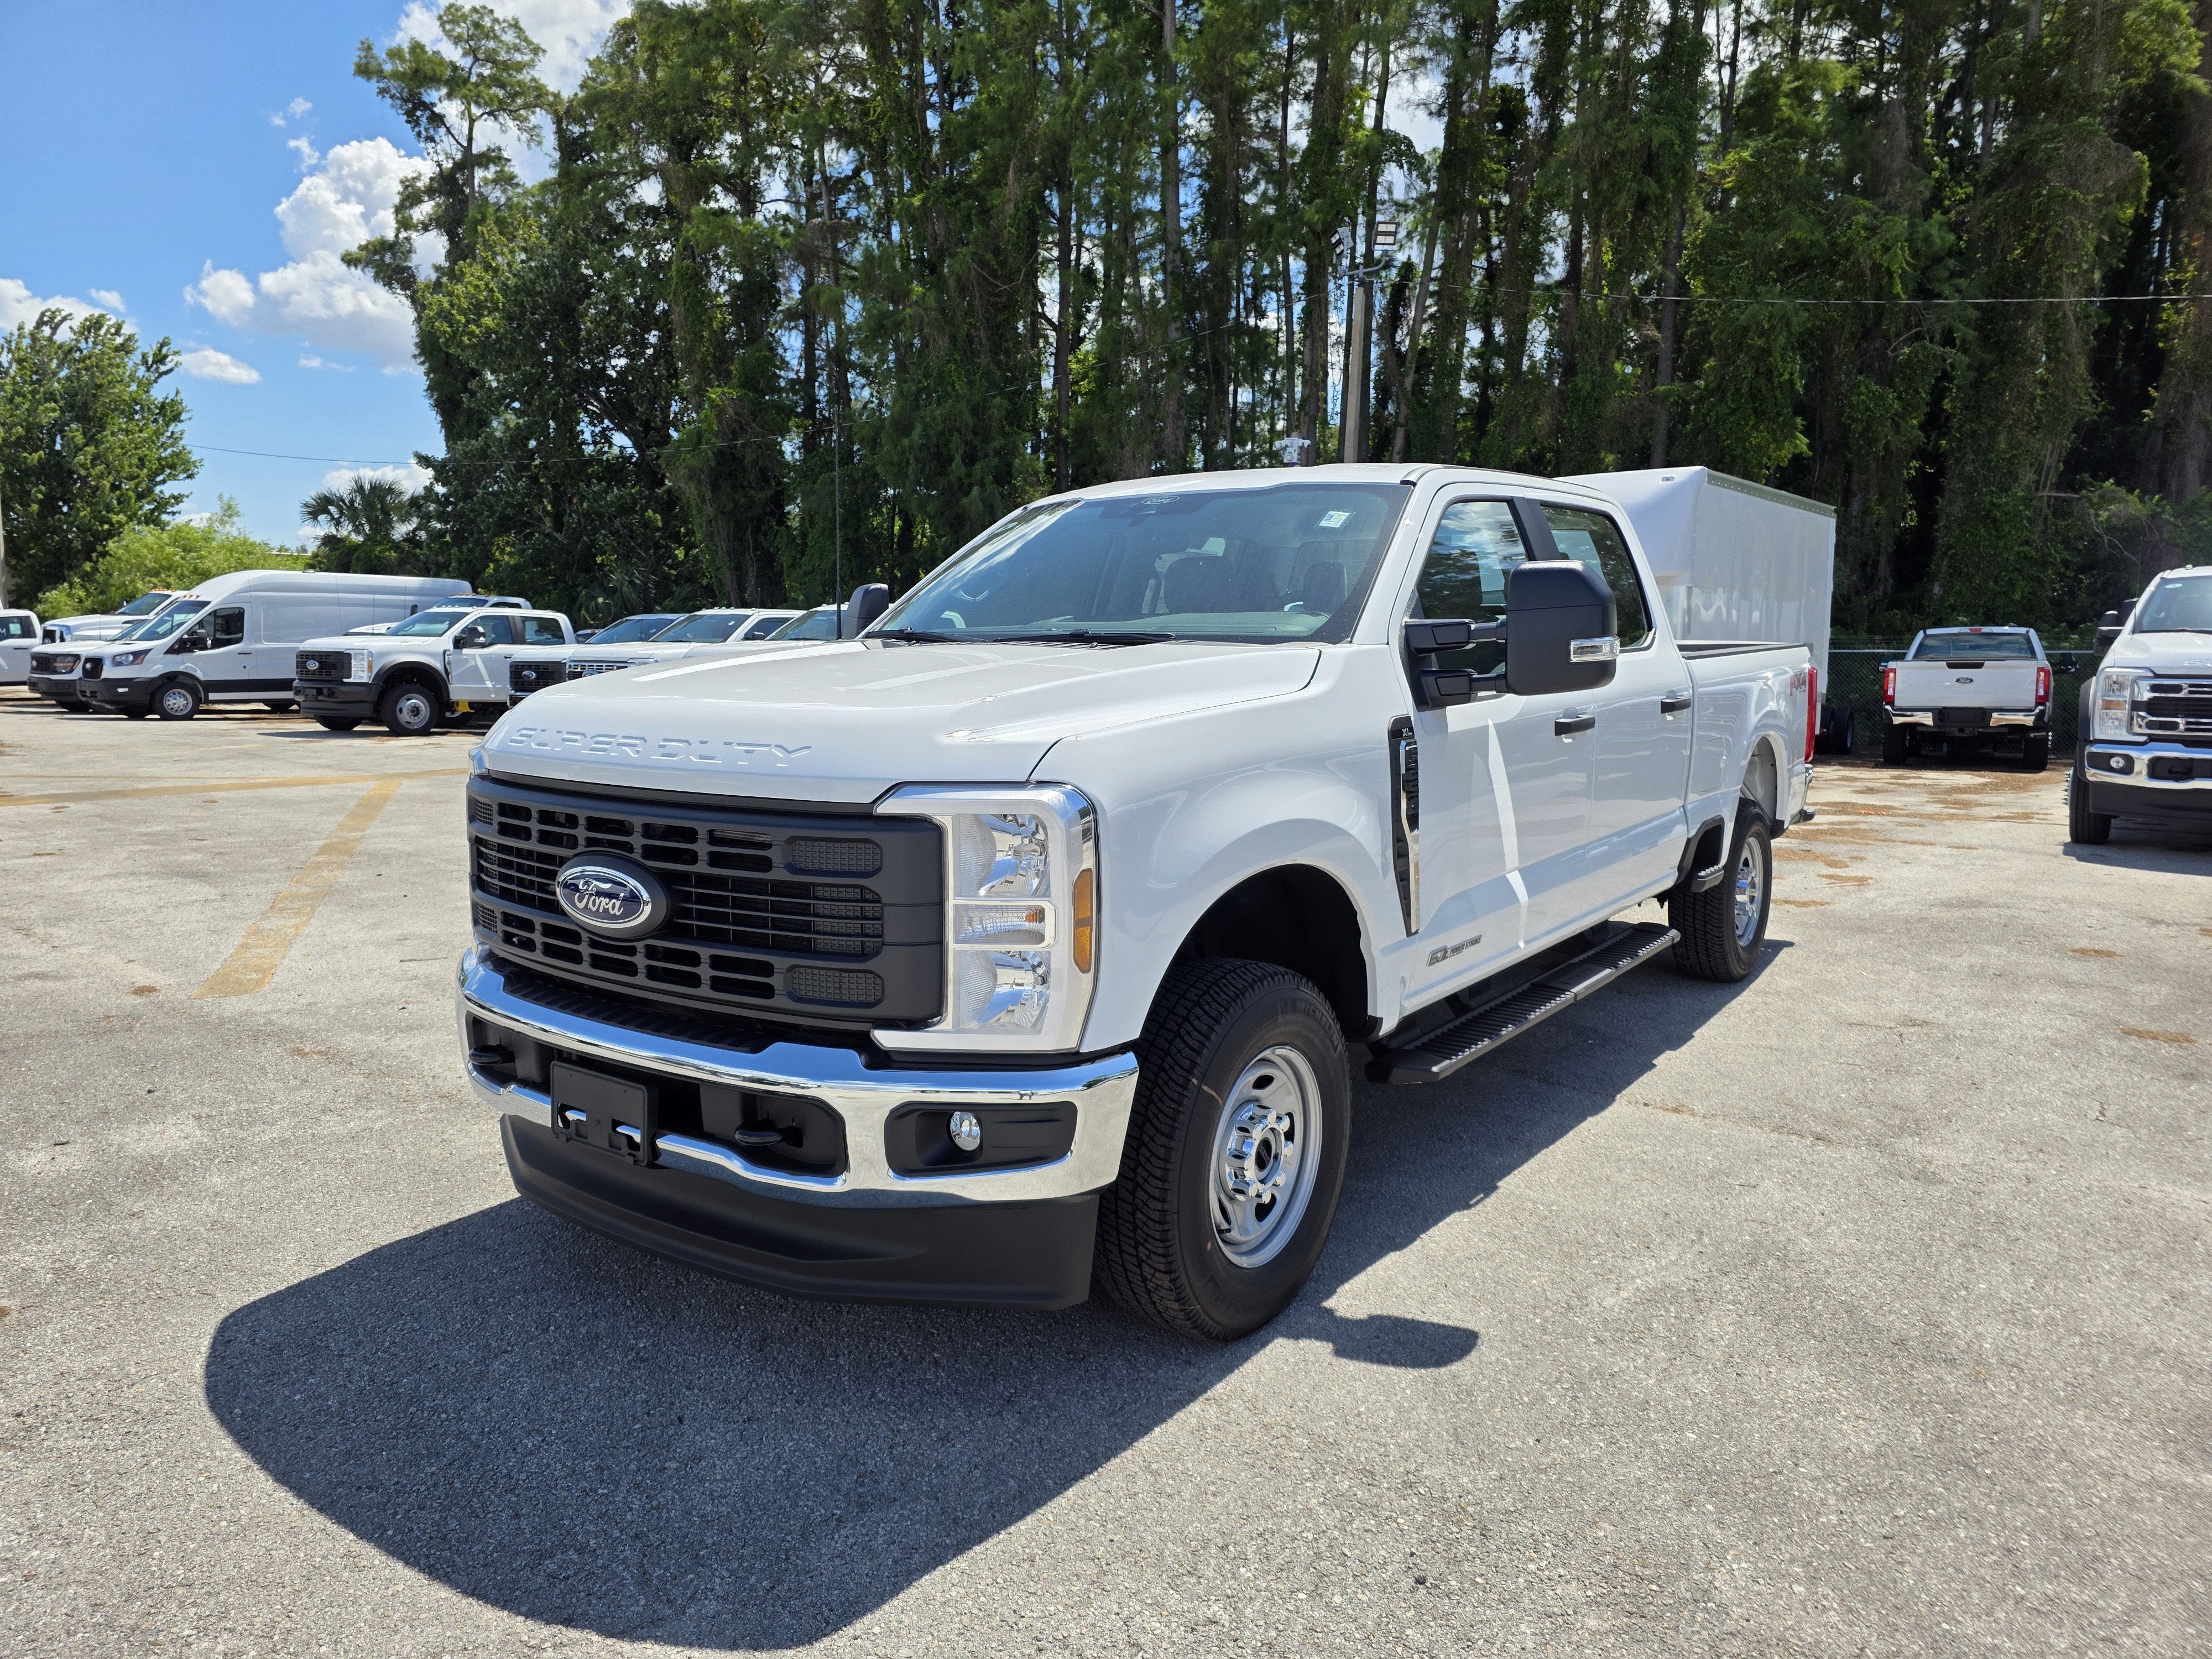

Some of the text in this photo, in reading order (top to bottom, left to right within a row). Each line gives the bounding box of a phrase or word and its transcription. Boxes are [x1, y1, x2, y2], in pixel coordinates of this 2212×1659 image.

[507, 727, 812, 766] SUPER DUTY
[1401, 728, 1412, 737] XL
[575, 878, 624, 915] Ford
